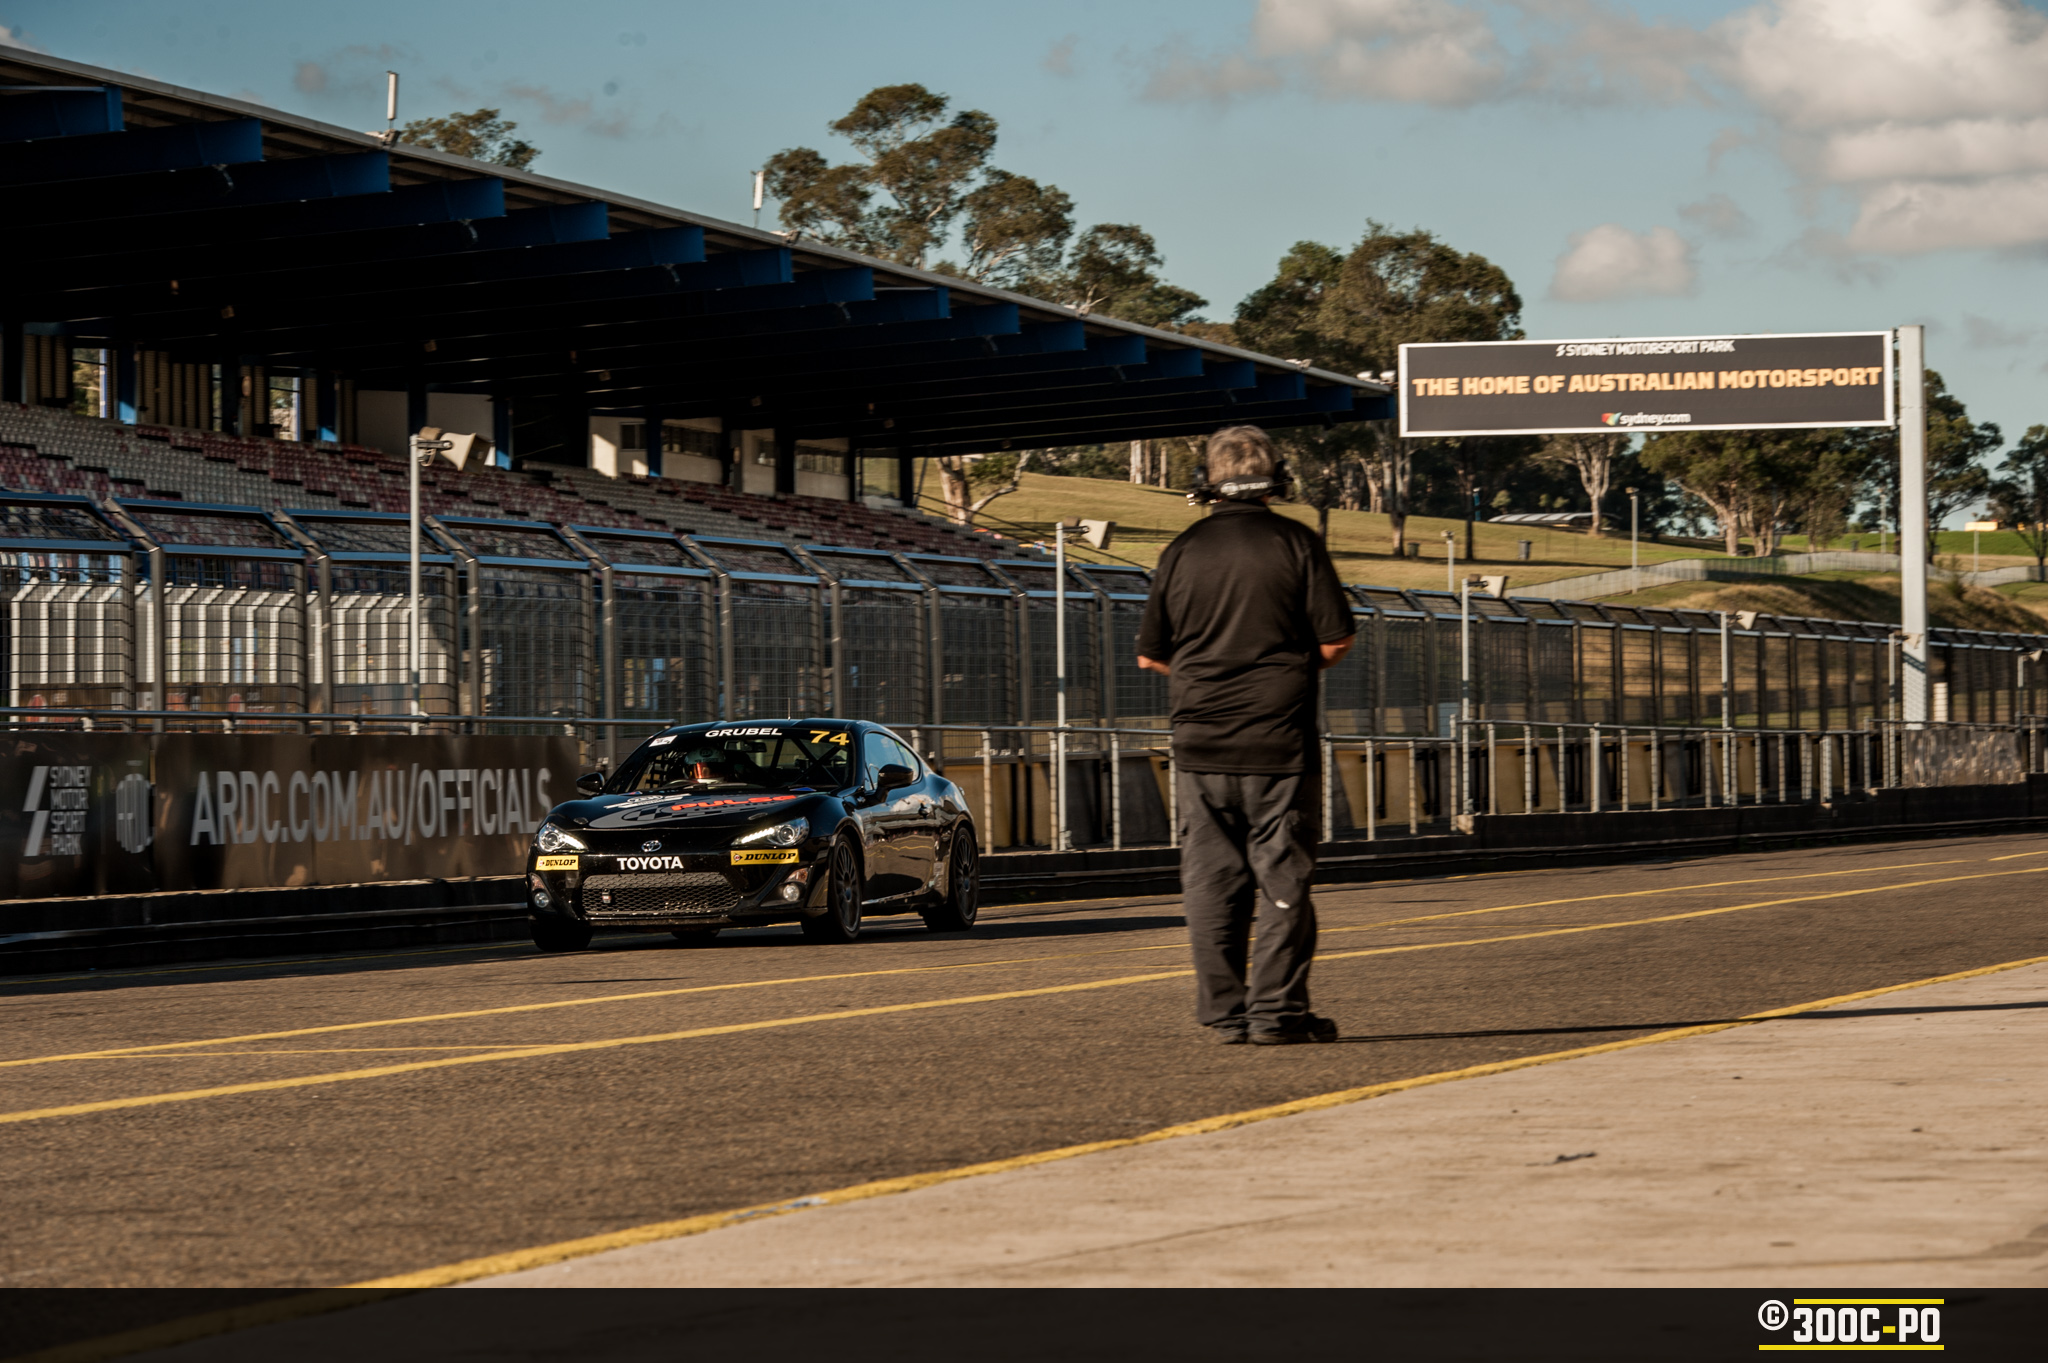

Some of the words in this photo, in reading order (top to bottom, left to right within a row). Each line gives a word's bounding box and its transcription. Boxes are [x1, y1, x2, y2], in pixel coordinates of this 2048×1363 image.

[1565, 343, 1616, 356] SYDNEY
[1616, 342, 1699, 355] MOTORSPORT
[1699, 340, 1736, 353] PARK
[1411, 377, 1459, 396] THE
[1462, 376, 1530, 395] HOME
[1533, 374, 1566, 394] OF
[1568, 371, 1715, 392] AUSTRALIAN
[1718, 366, 1882, 389] MOTORSPORT
[1619, 412, 1691, 426] sydney.com
[704, 727, 783, 738] GRUBEL
[809, 729, 850, 746] 74
[49, 765, 93, 787] SYDNEY
[49, 788, 90, 810] MOTOR
[190, 762, 553, 846] ARDC.COM.AU/OFFICIALS
[50, 810, 87, 833] SPORT
[51, 833, 83, 856] PARK
[545, 858, 576, 867] DUNLOP
[616, 856, 684, 871] TOYOTA
[744, 851, 798, 861] DUNLOP
